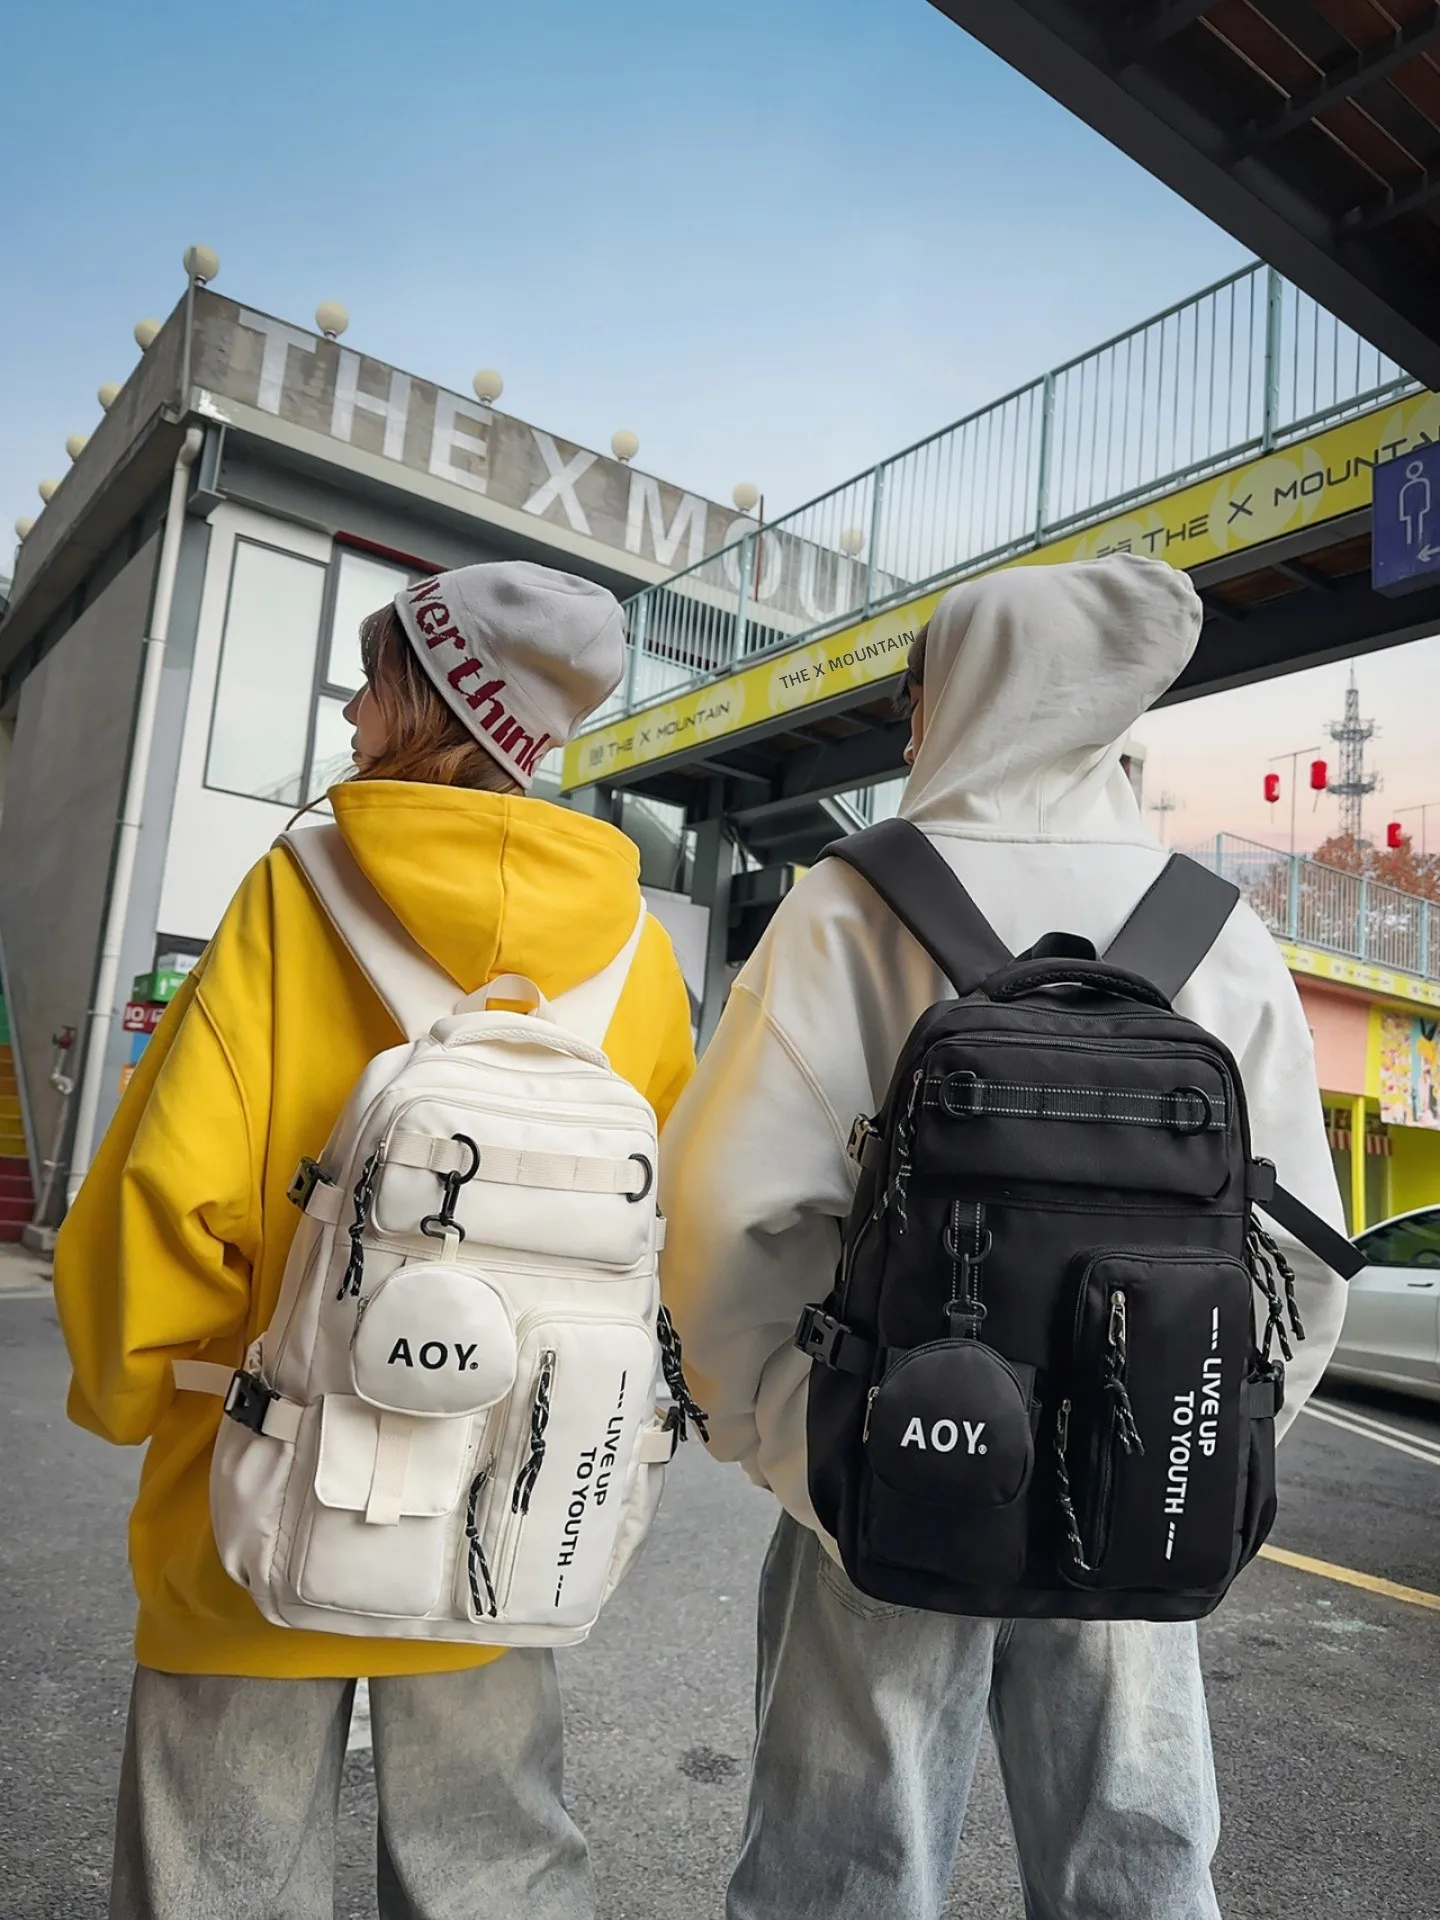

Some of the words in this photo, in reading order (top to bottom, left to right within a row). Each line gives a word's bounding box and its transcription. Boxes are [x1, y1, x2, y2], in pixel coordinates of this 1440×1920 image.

[238, 308, 493, 494] THE
[522, 427, 599, 536] X
[1142, 514, 1209, 553] THE
[1228, 494, 1253, 524] X
[778, 668, 811, 689] THE
[812, 662, 826, 677] X
[828, 630, 916, 672] MOUNTAIN
[608, 737, 633, 757] THE
[639, 728, 652, 746] X
[656, 701, 731, 739] MOUNTAIN
[1172, 1390, 1195, 1426] TO
[1200, 1357, 1222, 1416] LIVE
[576, 1446, 597, 1480] TO
[600, 1416, 624, 1468] LIVE
[1198, 1419, 1218, 1457] UP
[593, 1471, 611, 1506] UP
[1164, 1430, 1192, 1514] YOUTH
[557, 1484, 590, 1567] YOUTH
